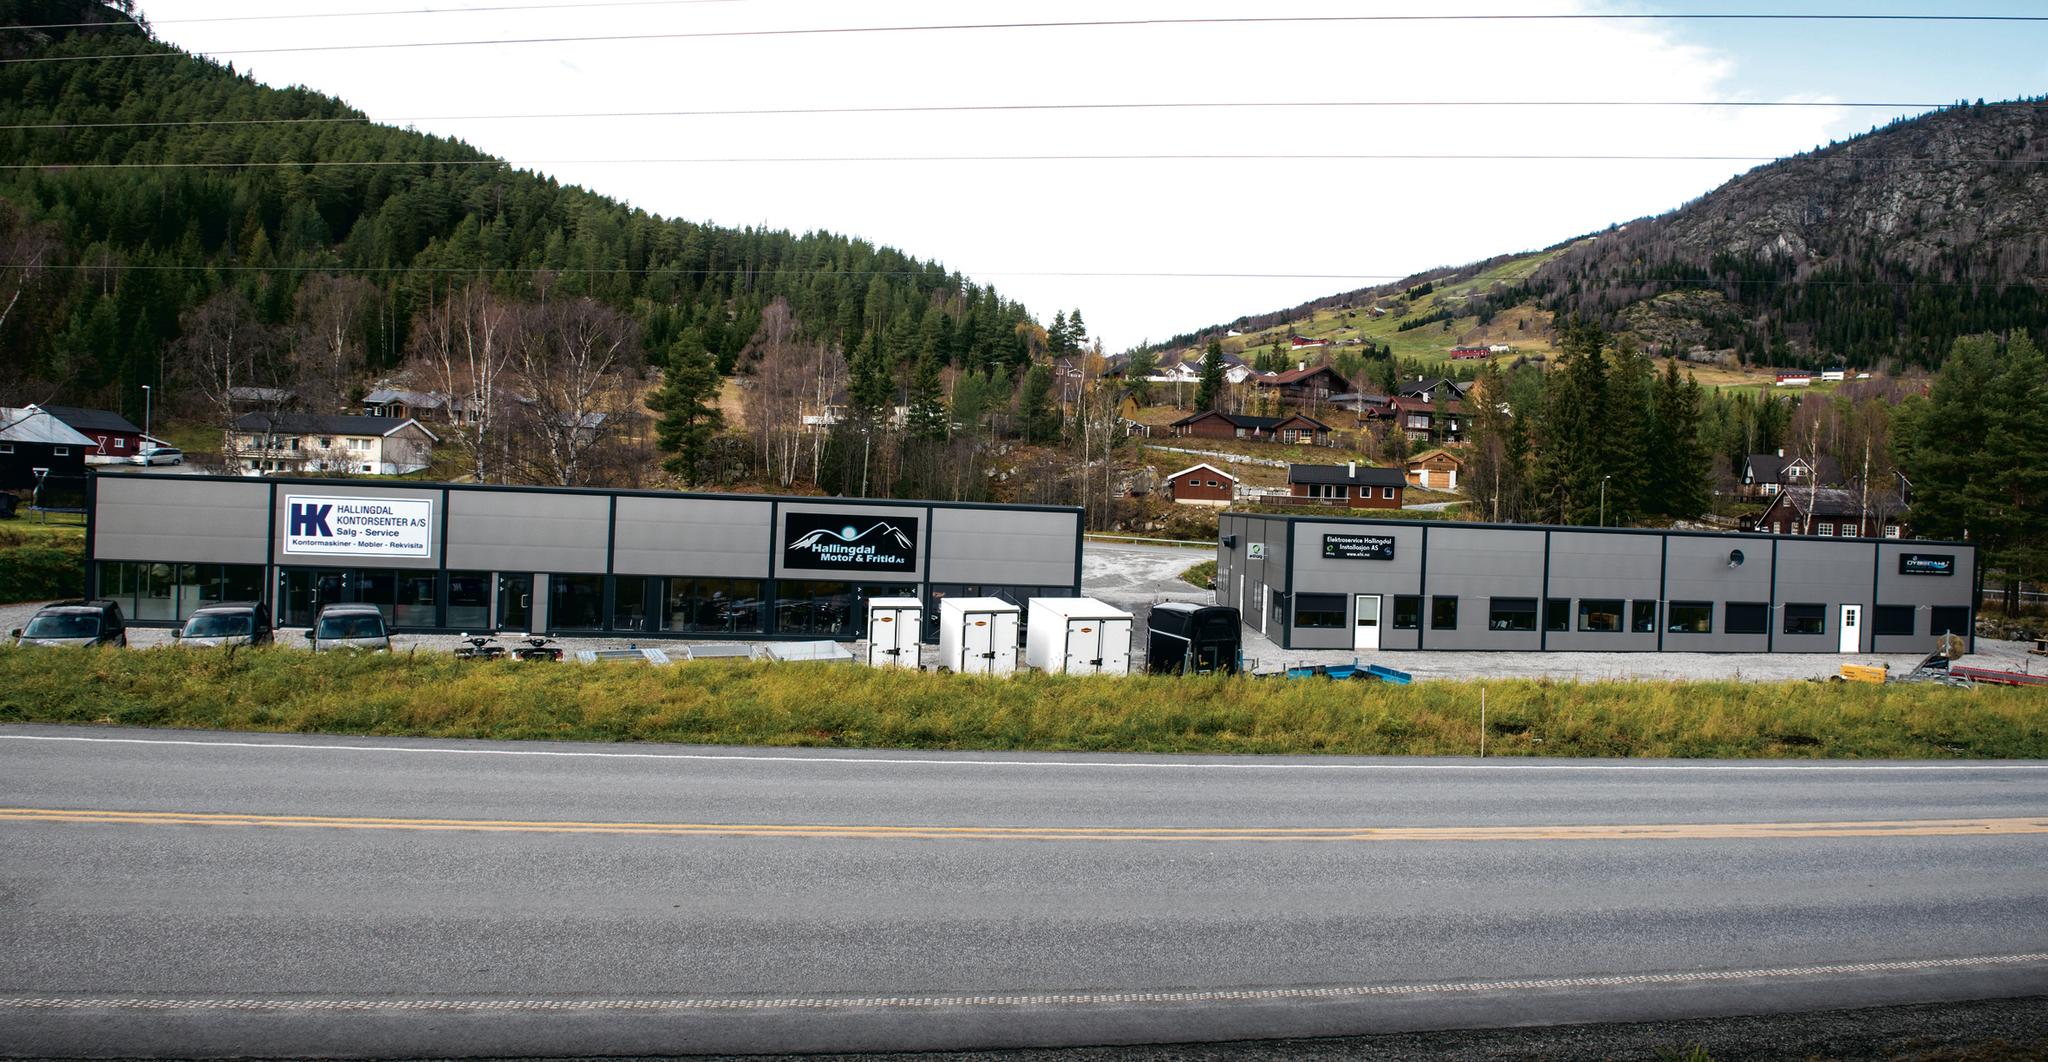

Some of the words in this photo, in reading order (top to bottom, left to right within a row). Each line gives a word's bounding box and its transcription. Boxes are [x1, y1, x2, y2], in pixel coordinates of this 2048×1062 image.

[337, 505, 393, 515] HALLINGDAL
[290, 503, 333, 537] HK
[337, 516, 408, 527] KONTORSENTER
[410, 518, 426, 528] A/S
[336, 528, 357, 537] Salg
[365, 528, 400, 537] Service
[292, 539, 352, 547] Kontormaskiner
[1326, 536, 1363, 544] Elektroservice
[1364, 537, 1392, 546] Hallingdal
[811, 543, 875, 556] Hallingdal
[1339, 544, 1370, 552] Installasjon
[820, 553, 854, 562] Motor
[855, 554, 864, 562] &
[866, 554, 895, 563] Fritid
